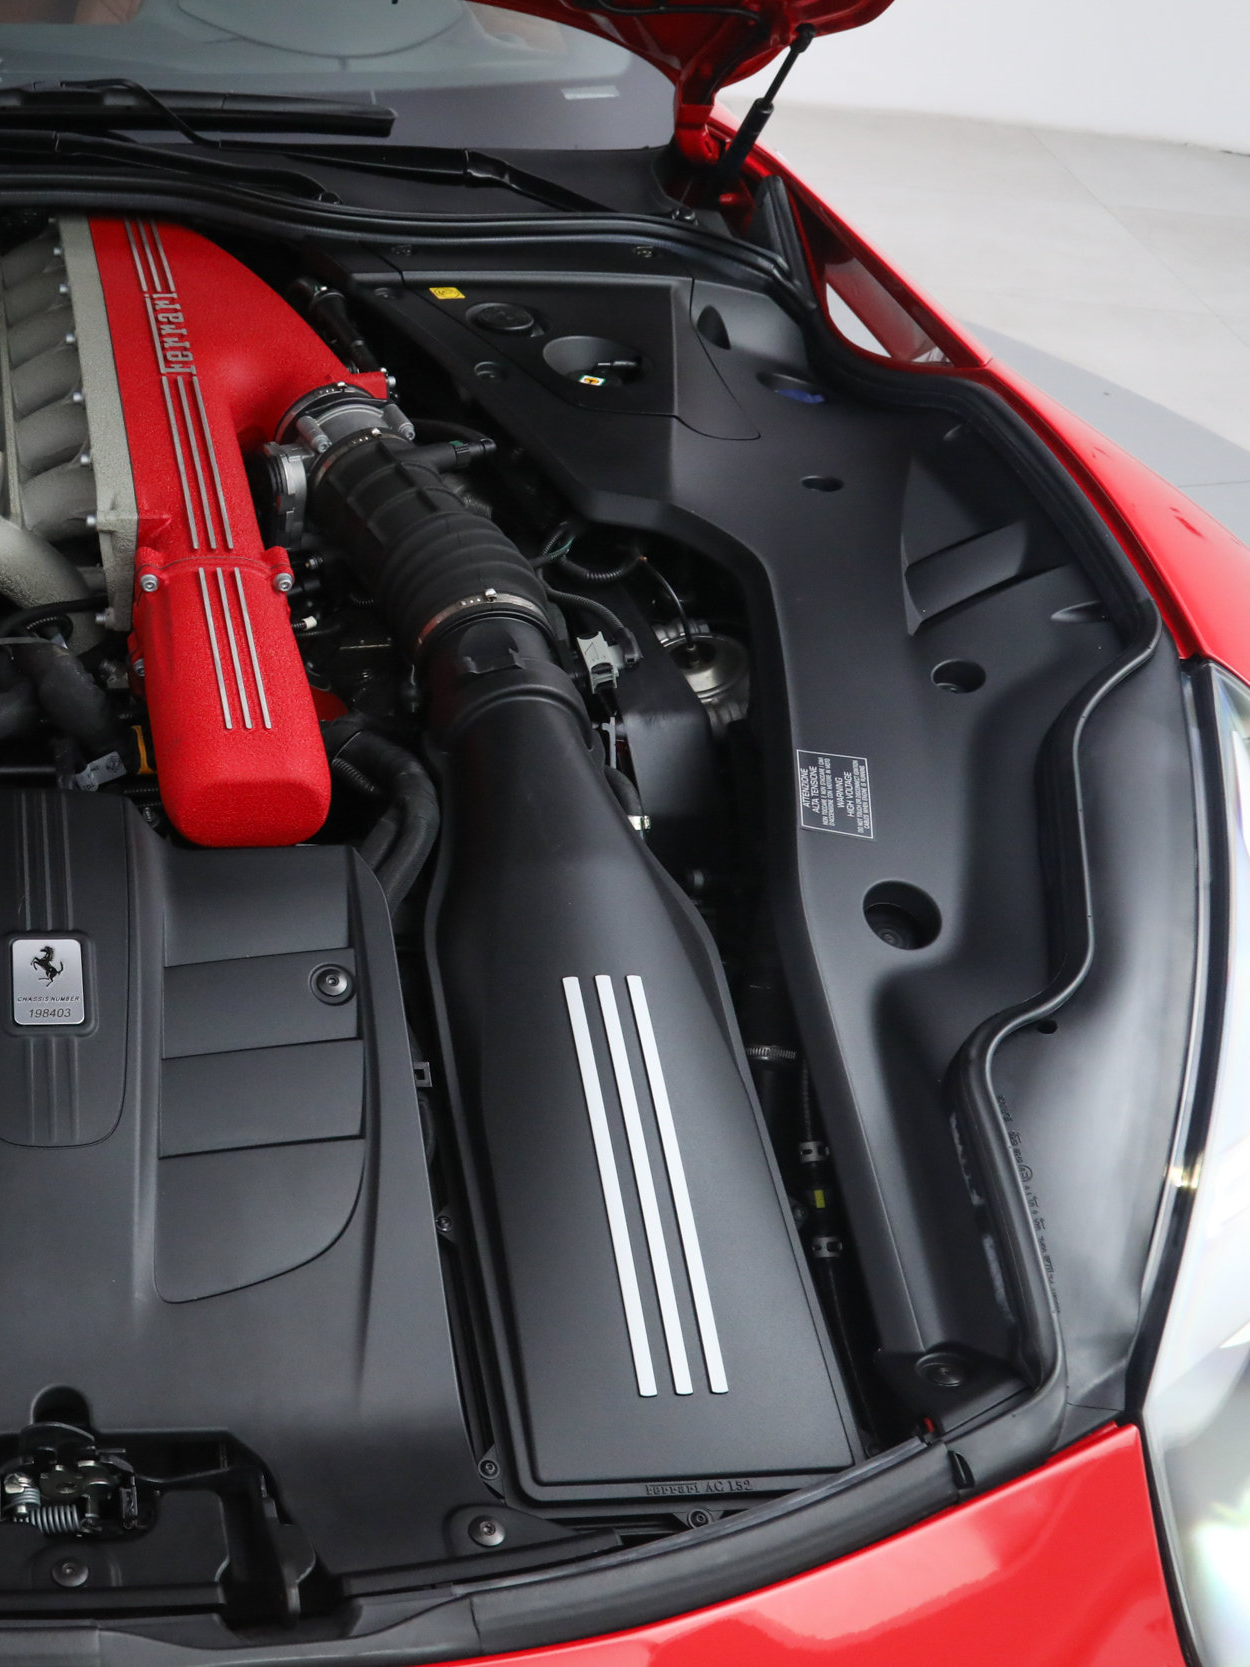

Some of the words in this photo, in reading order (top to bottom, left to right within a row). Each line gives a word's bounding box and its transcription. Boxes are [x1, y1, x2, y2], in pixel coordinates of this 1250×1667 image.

[144, 293, 196, 374] Ferrari
[800, 768, 810, 808] ATTENZIONE
[809, 766, 819, 797] TENSIONE
[835, 777, 845, 808] WARNING
[844, 771, 853, 799] VOLTAGE
[811, 798, 820, 814] ALTA
[846, 800, 855, 817] HIGH
[29, 1008, 71, 1017] 198403
[645, 1482, 699, 1495] Ferrari
[705, 1481, 724, 1493] AC
[728, 1480, 753, 1491] 152
